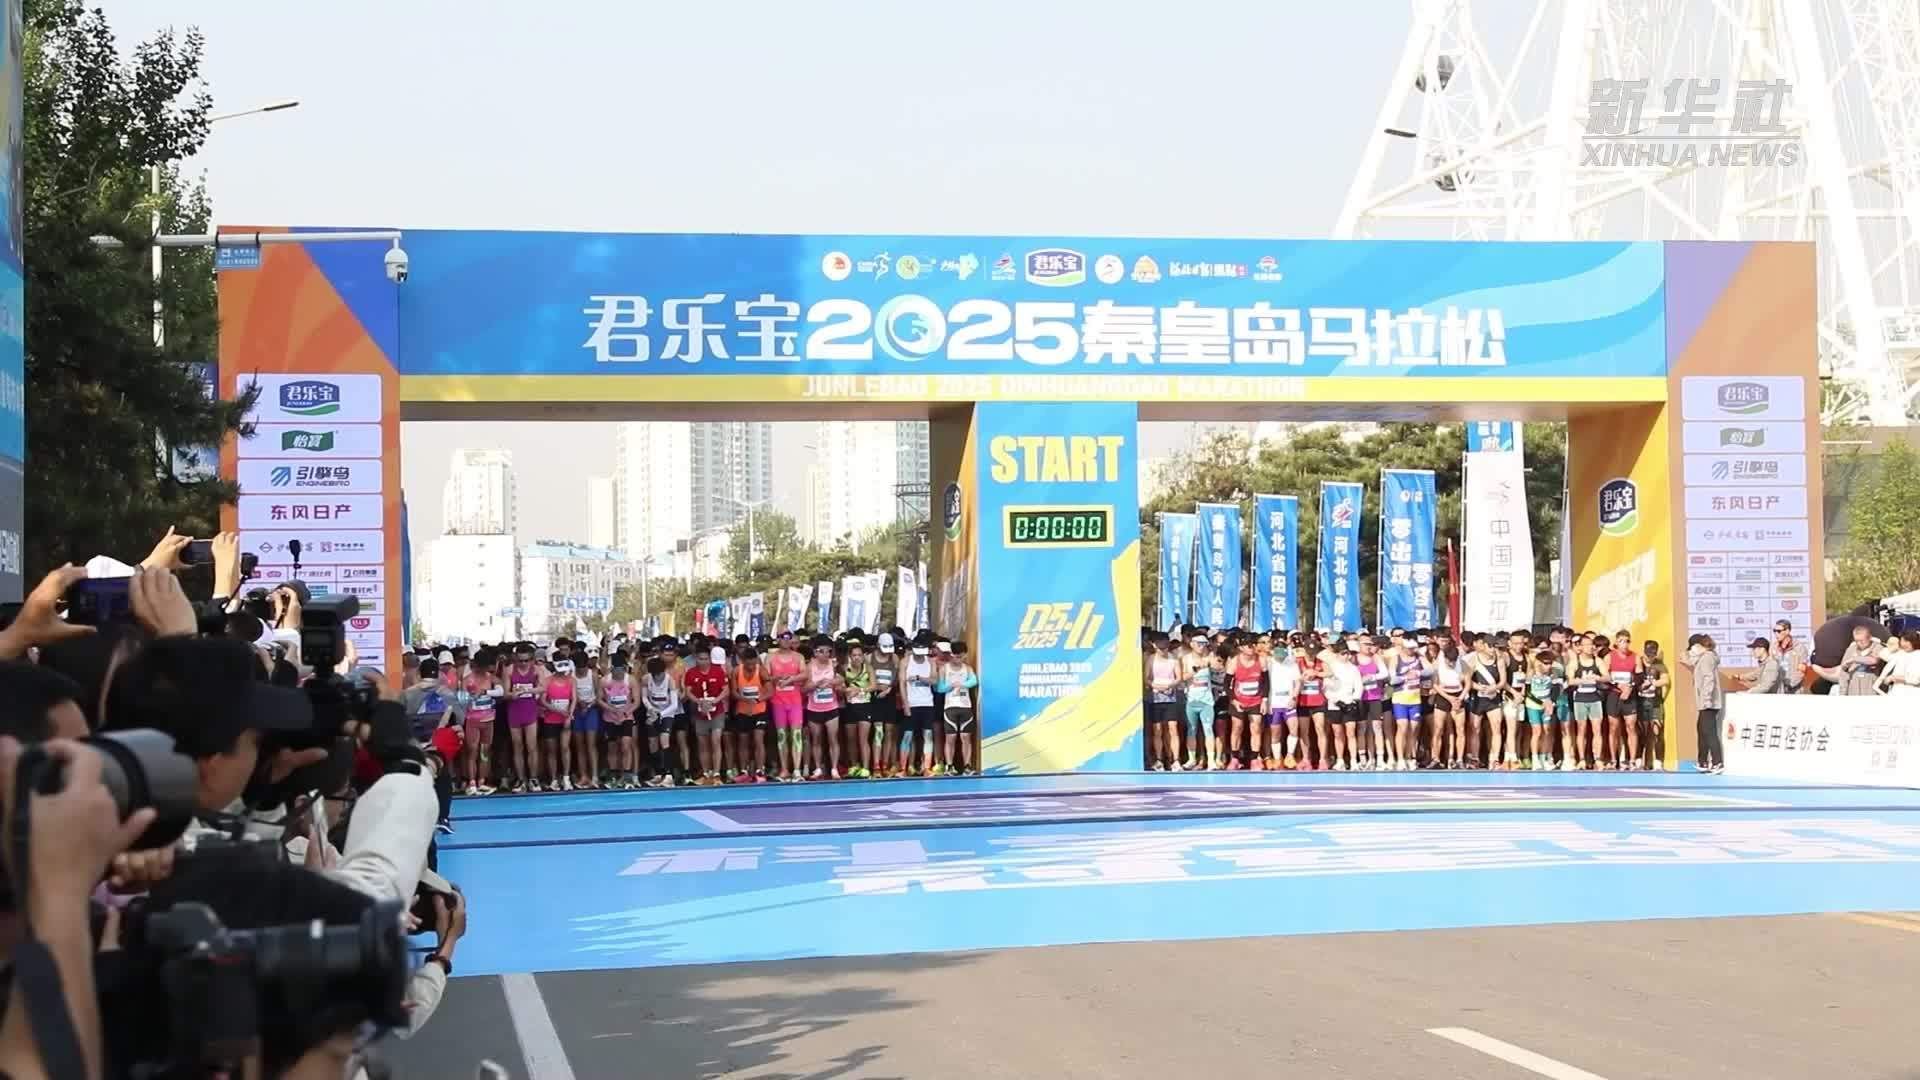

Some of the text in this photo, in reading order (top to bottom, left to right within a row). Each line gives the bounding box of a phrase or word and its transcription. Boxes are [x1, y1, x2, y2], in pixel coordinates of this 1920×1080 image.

[1033, 254, 1078, 270] 君乐宝
[286, 385, 334, 401] 君乐宝
[1724, 386, 1764, 401] 君乐宝
[990, 435, 1125, 484] START
[296, 466, 350, 480] 引擎鸟
[1711, 496, 1780, 510] 东风日产
[270, 504, 353, 520] 东风日产
[1015, 516, 1102, 539] 0:00:00
[1012, 631, 1061, 649] 2025
[1741, 723, 1831, 751] 中国田径协会
